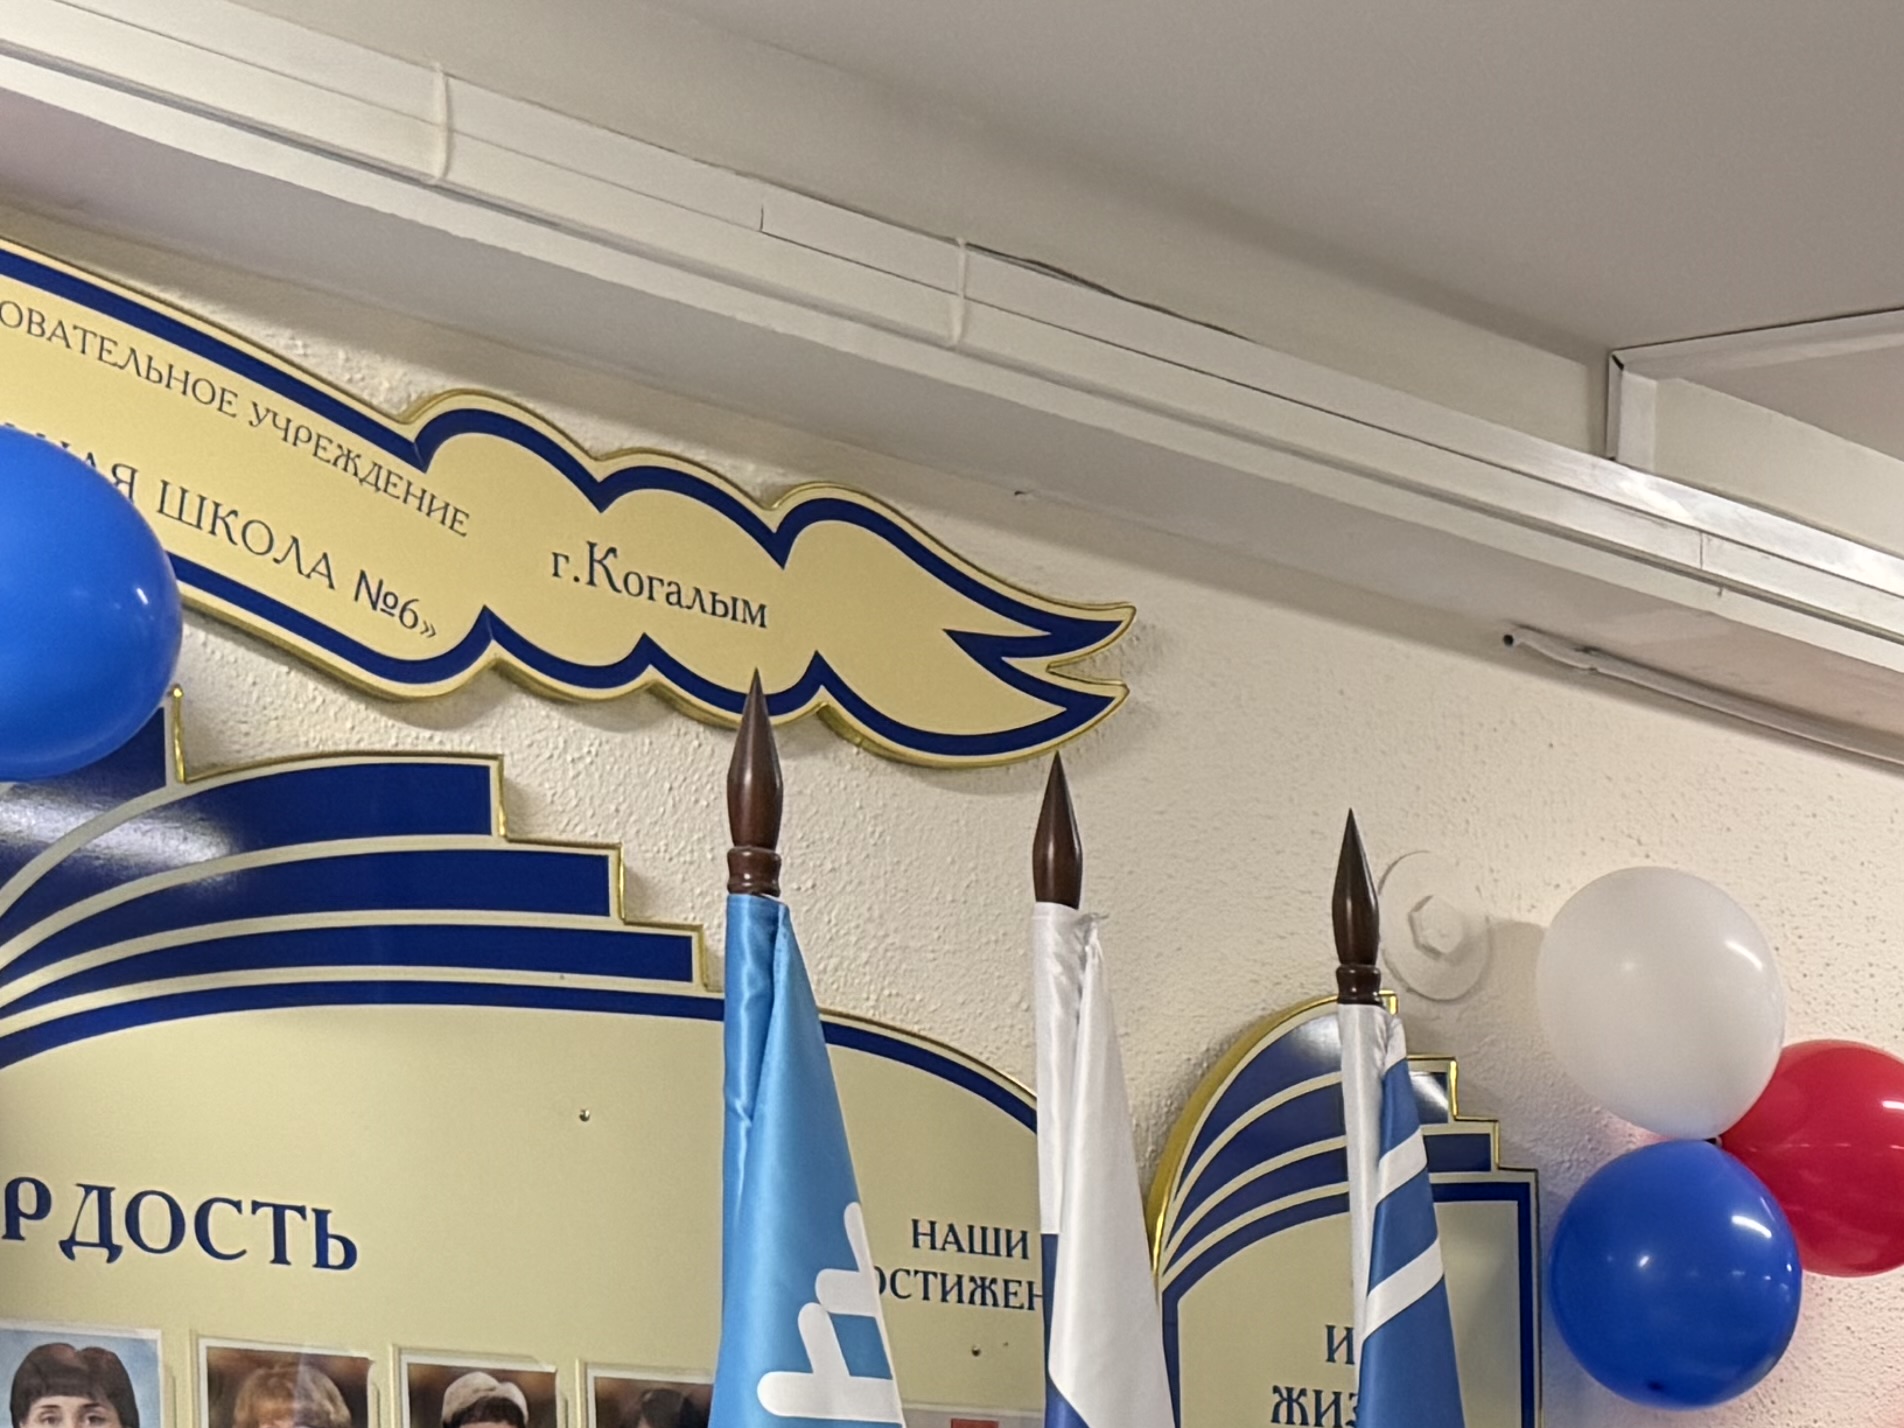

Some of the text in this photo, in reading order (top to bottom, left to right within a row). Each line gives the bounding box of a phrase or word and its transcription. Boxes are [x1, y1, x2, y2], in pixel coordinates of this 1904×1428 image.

[248, 401, 470, 537] УЧРЕЖДЕНИЕ
[156, 479, 437, 640] ШКОЛА №6»
[2, 1176, 359, 1272] РДОСТЬ
[911, 1218, 1029, 1260] НАШИ
